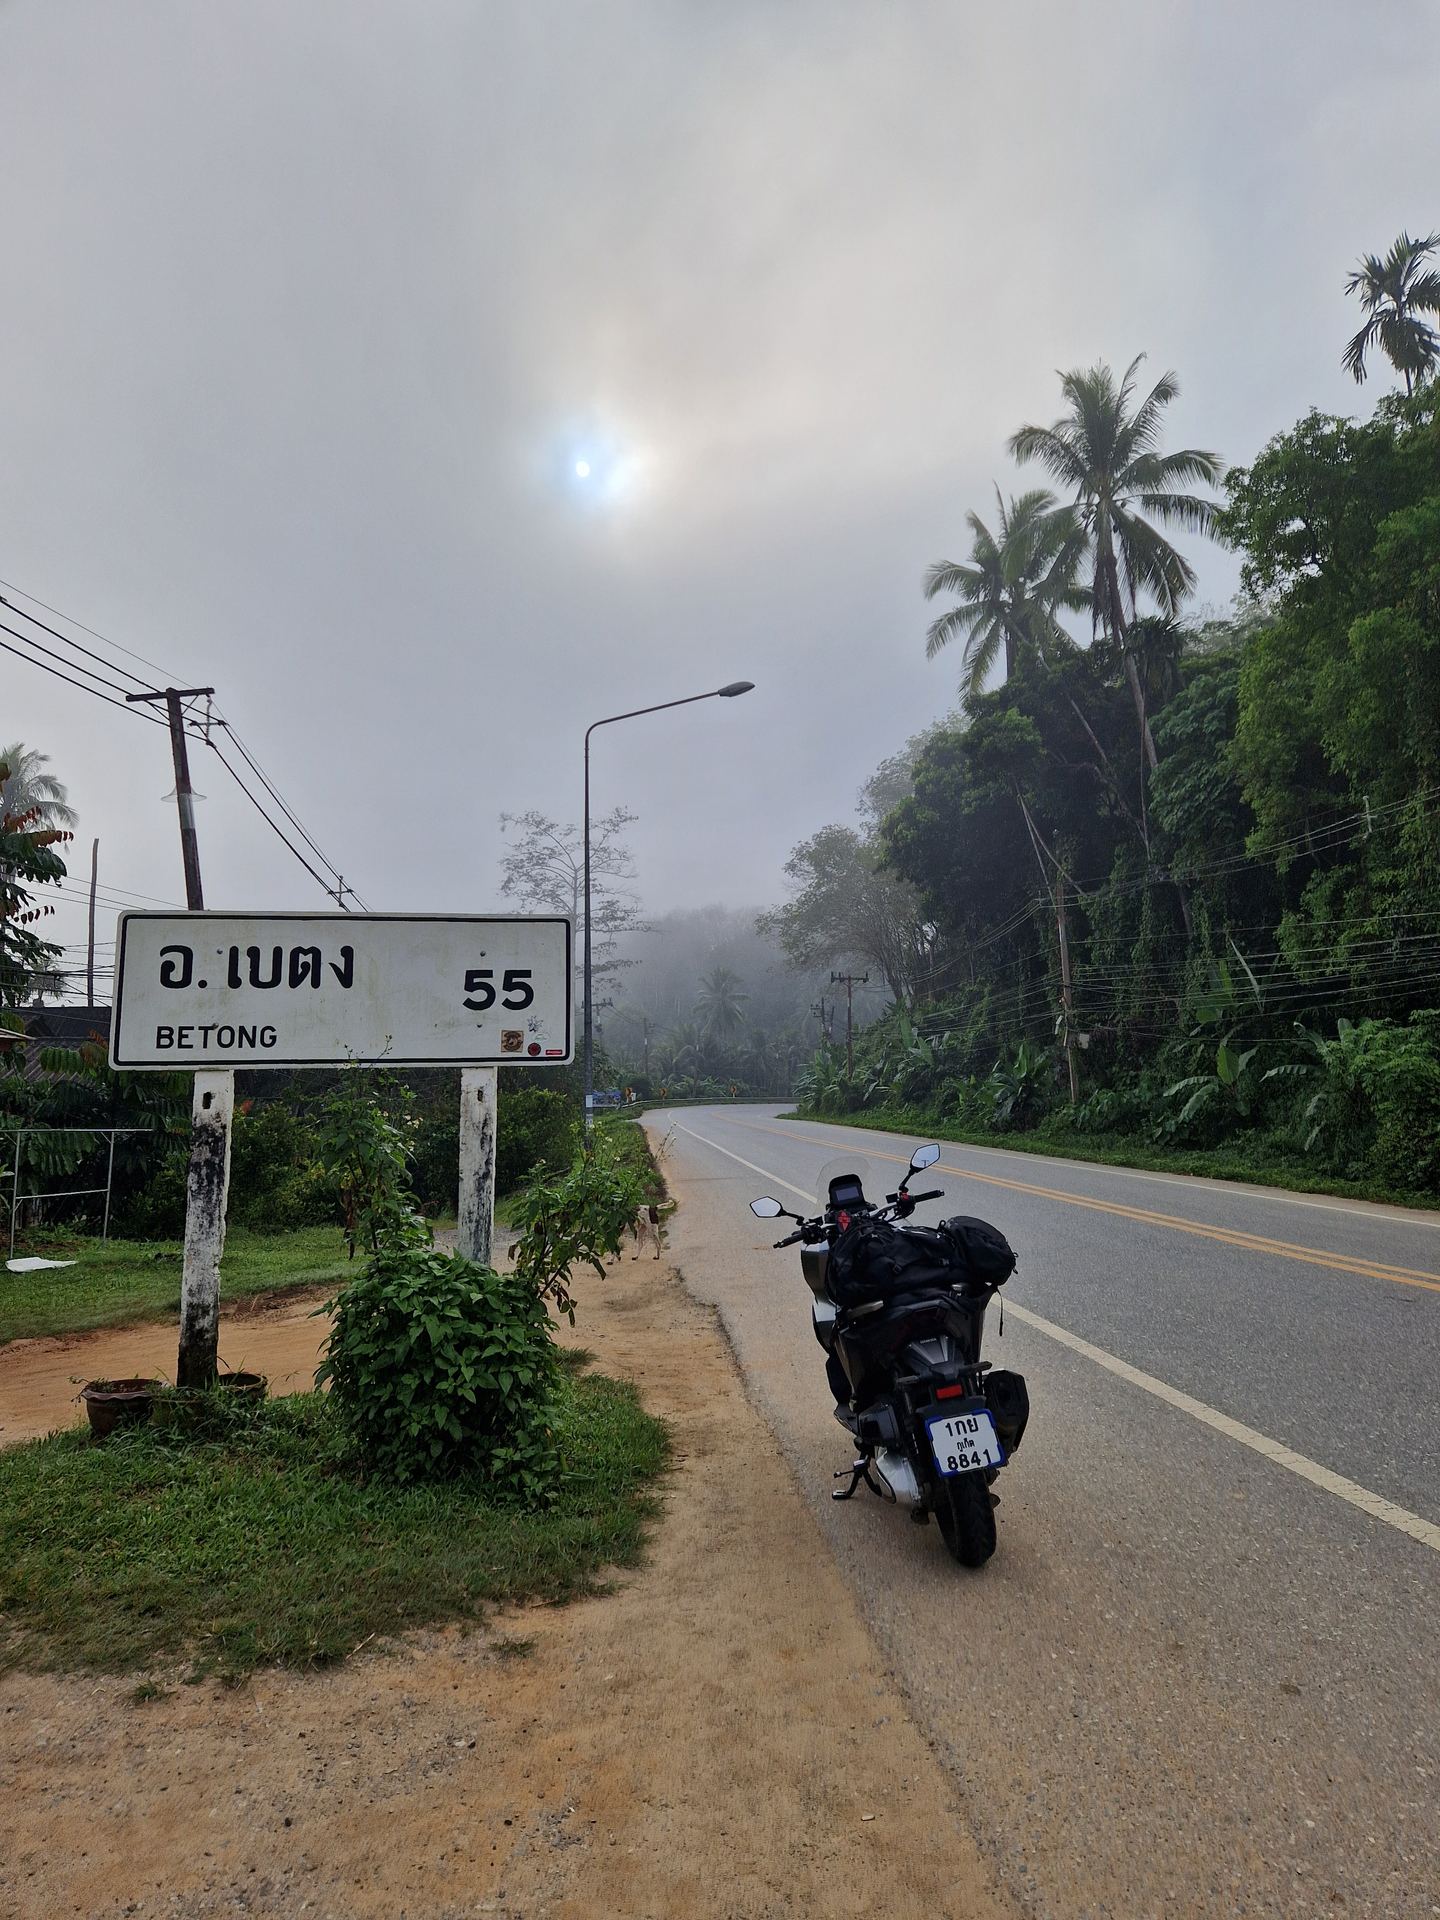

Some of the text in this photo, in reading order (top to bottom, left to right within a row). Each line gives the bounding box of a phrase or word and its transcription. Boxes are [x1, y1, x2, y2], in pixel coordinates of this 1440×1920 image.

[462, 969, 535, 1011] 55
[156, 1025, 278, 1050] BETONG
[947, 1449, 991, 1470] 8841
